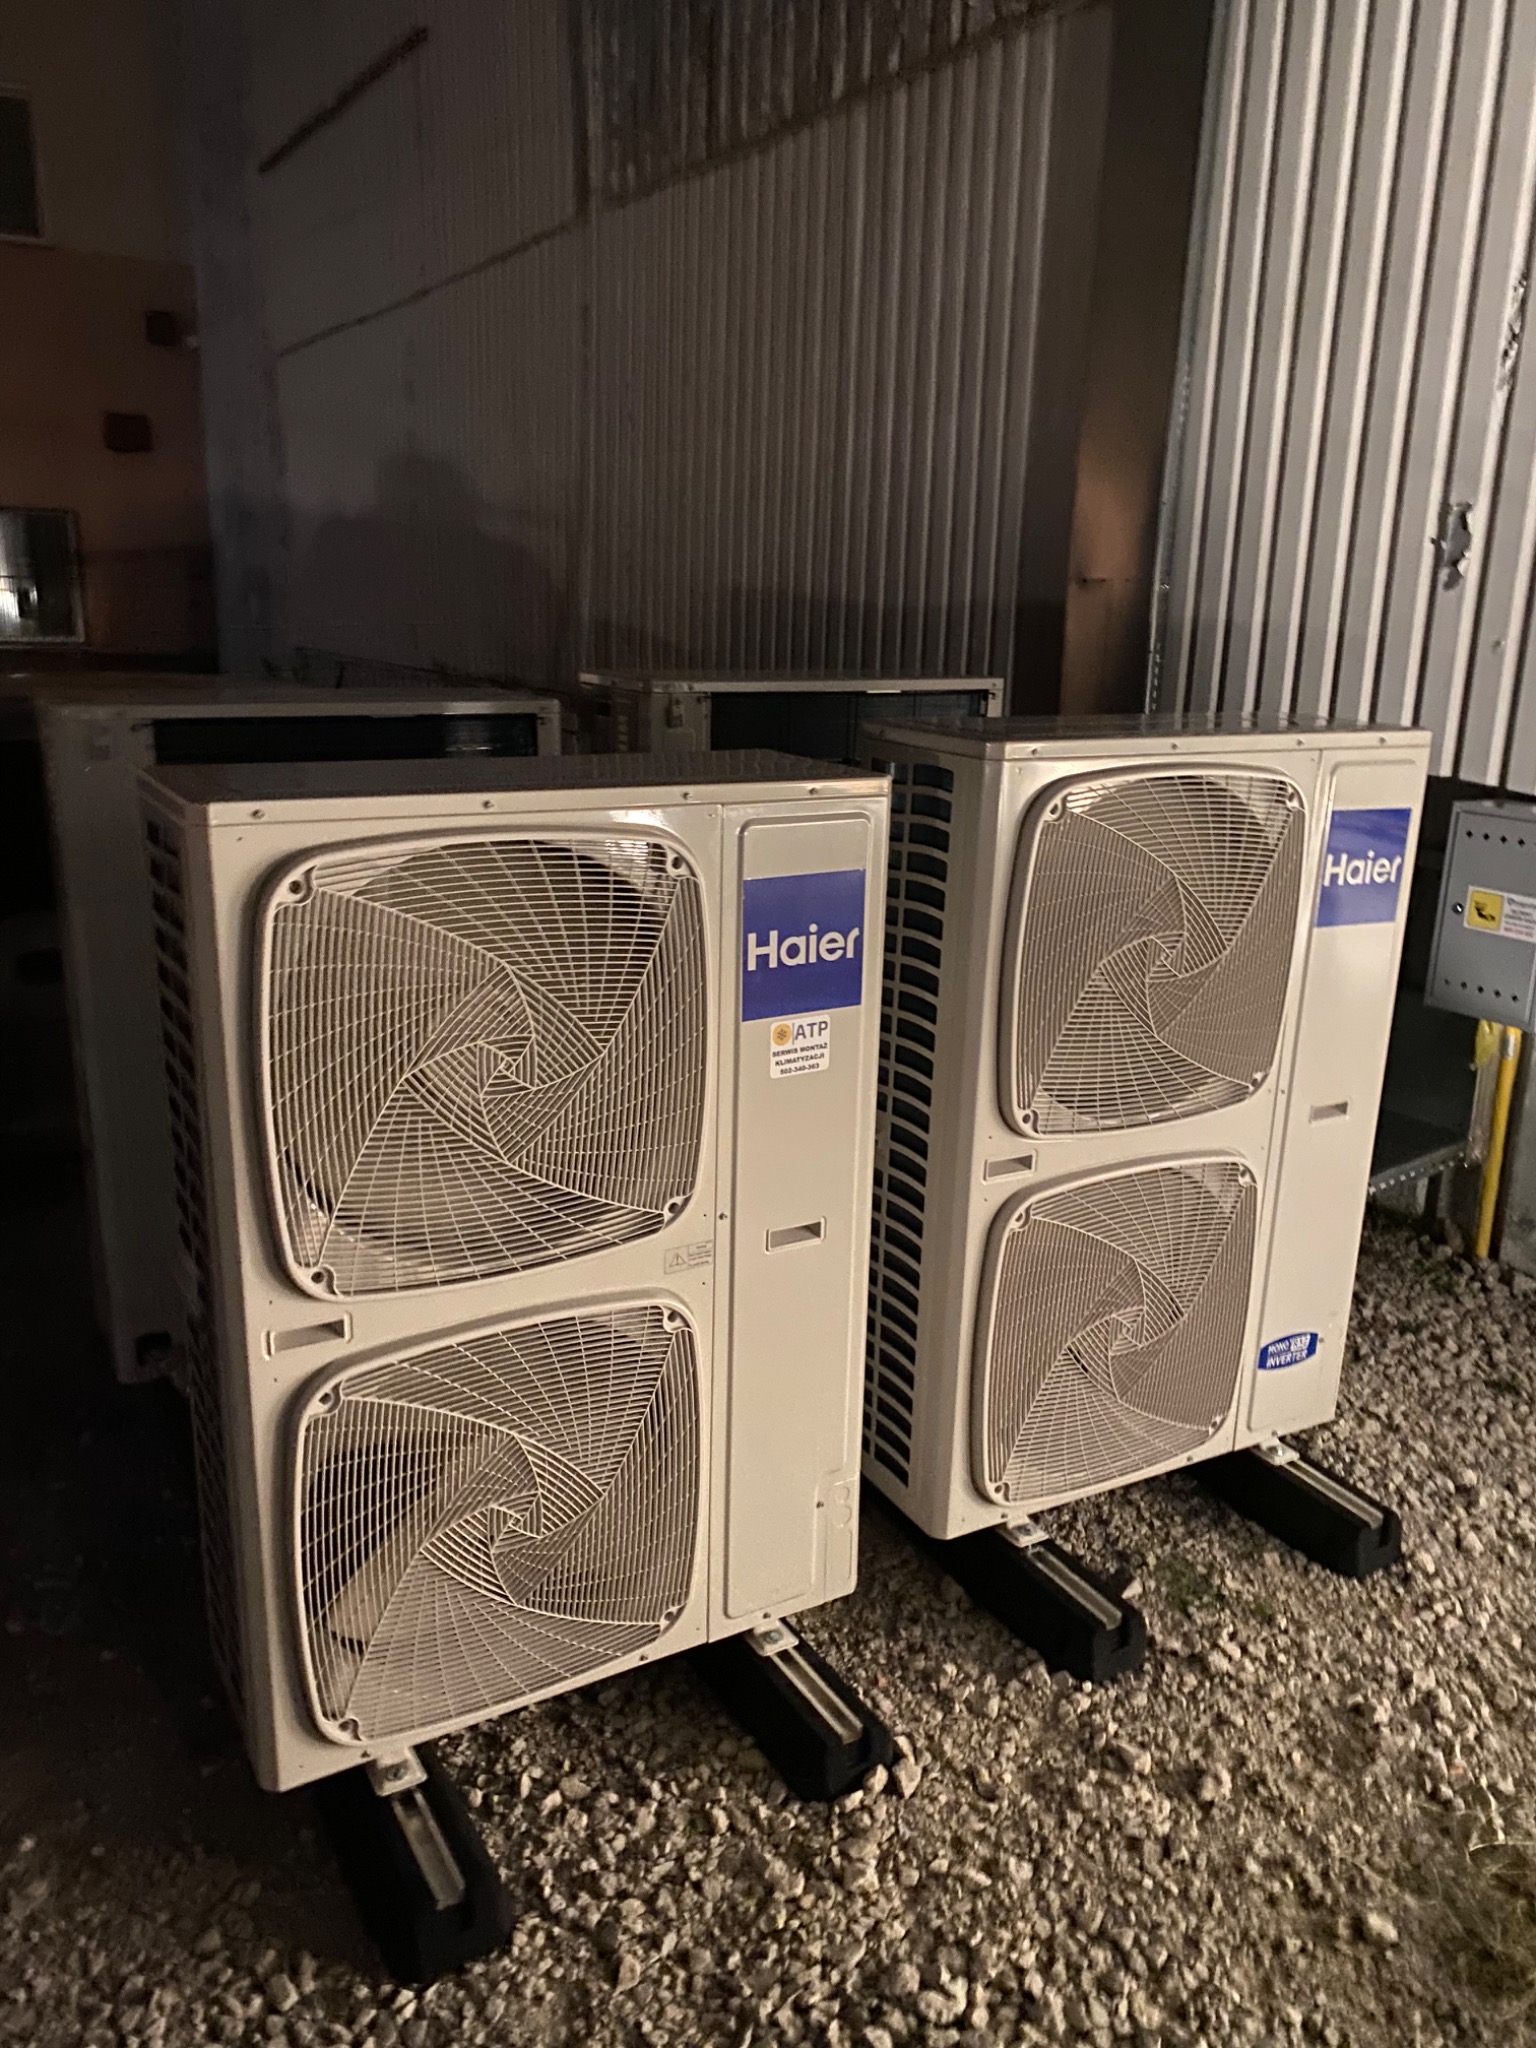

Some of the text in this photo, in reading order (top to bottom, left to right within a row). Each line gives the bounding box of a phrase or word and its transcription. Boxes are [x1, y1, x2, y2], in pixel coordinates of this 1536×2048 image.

[1323, 849, 1402, 887] Haier
[747, 923, 860, 971] Haier
[795, 1021, 828, 1040] ATP
[772, 1042, 828, 1058] SERWIS MONTAŻ
[775, 1053, 825, 1066] KLIMATYZACJI
[1266, 1349, 1308, 1369] INVERTER
